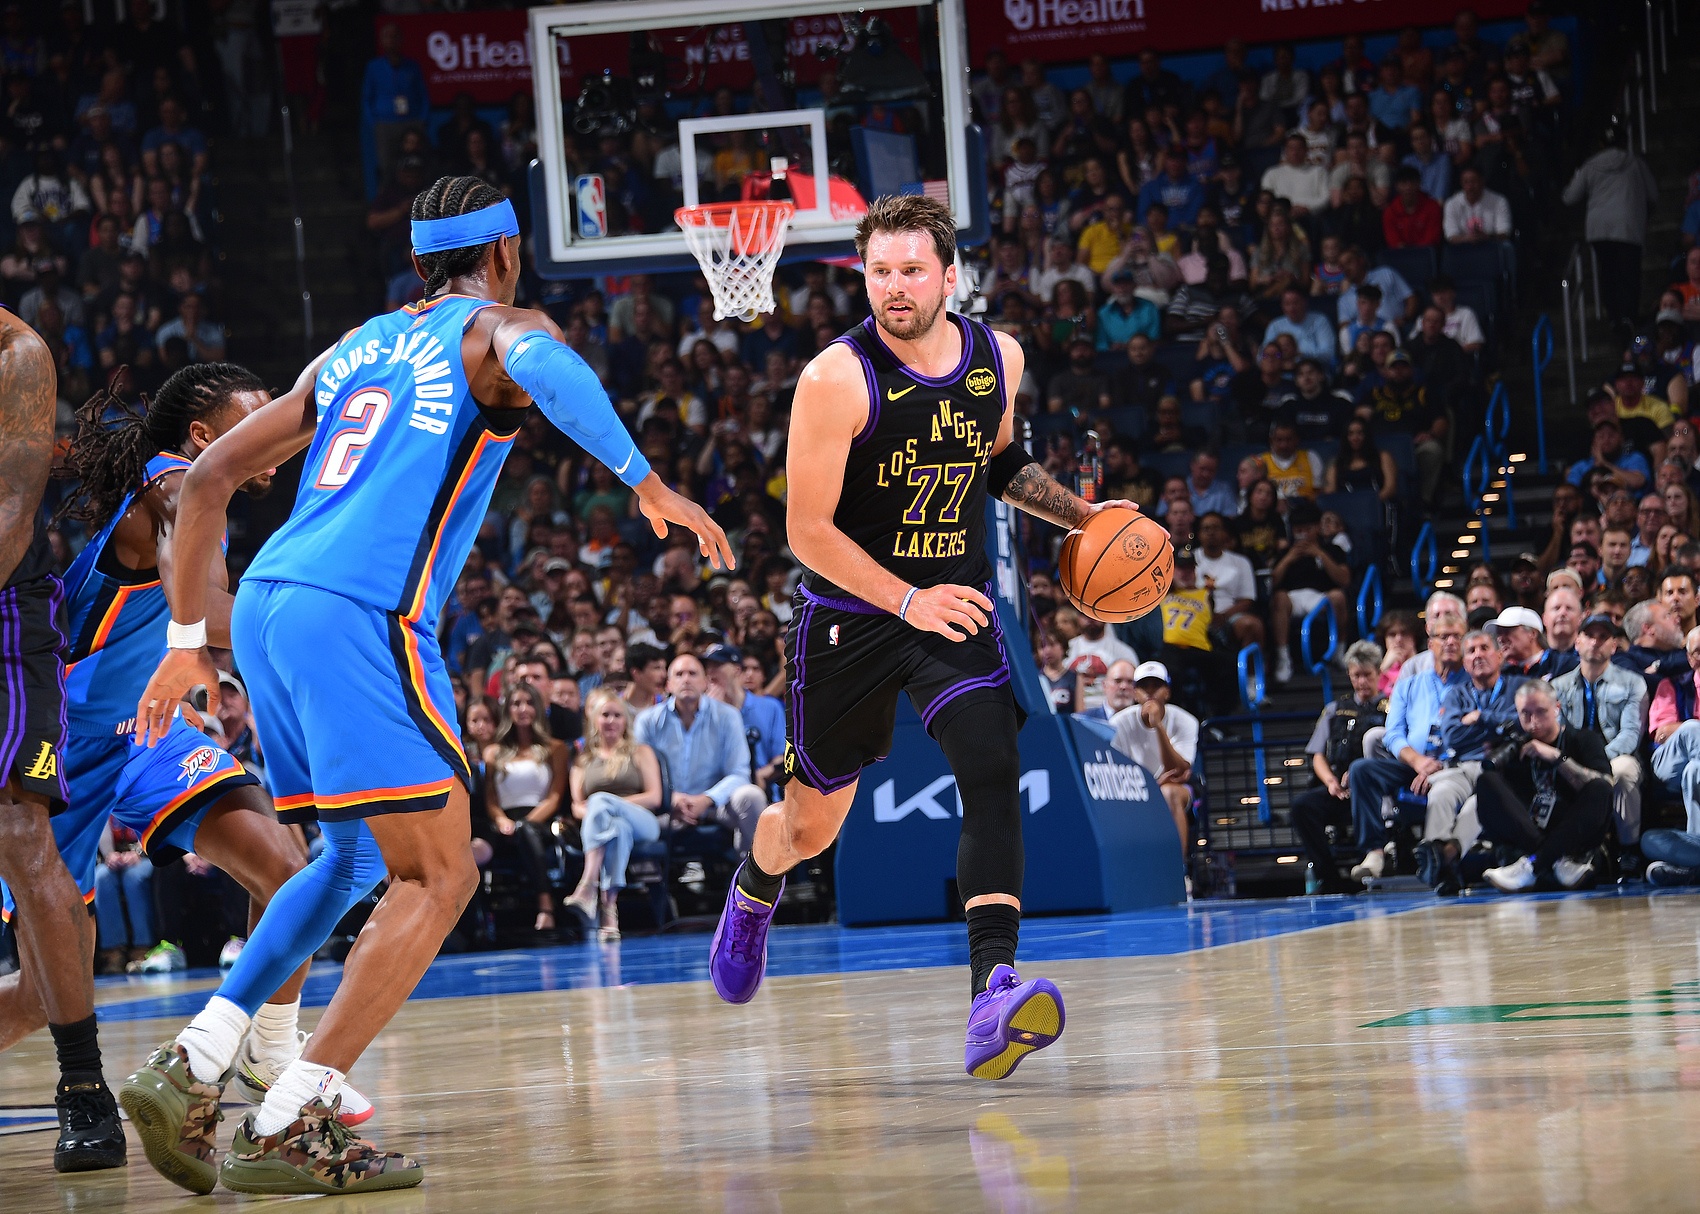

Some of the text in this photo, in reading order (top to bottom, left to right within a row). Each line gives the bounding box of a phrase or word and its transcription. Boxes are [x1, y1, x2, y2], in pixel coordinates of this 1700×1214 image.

[1038, 0, 1145, 27] Health
[460, 28, 571, 68] Healh
[686, 41, 749, 64] NEVE
[968, 375, 993, 388] bibigo
[314, 386, 392, 490] 2
[877, 400, 993, 487] LOS ANGELE
[902, 462, 976, 524] 77
[893, 528, 967, 558] LAKERS
[1166, 607, 1195, 630] 77
[25, 741, 57, 780] LA
[188, 749, 211, 777] OKC
[1083, 750, 1149, 802] coinbase
[873, 768, 1050, 823] KA
